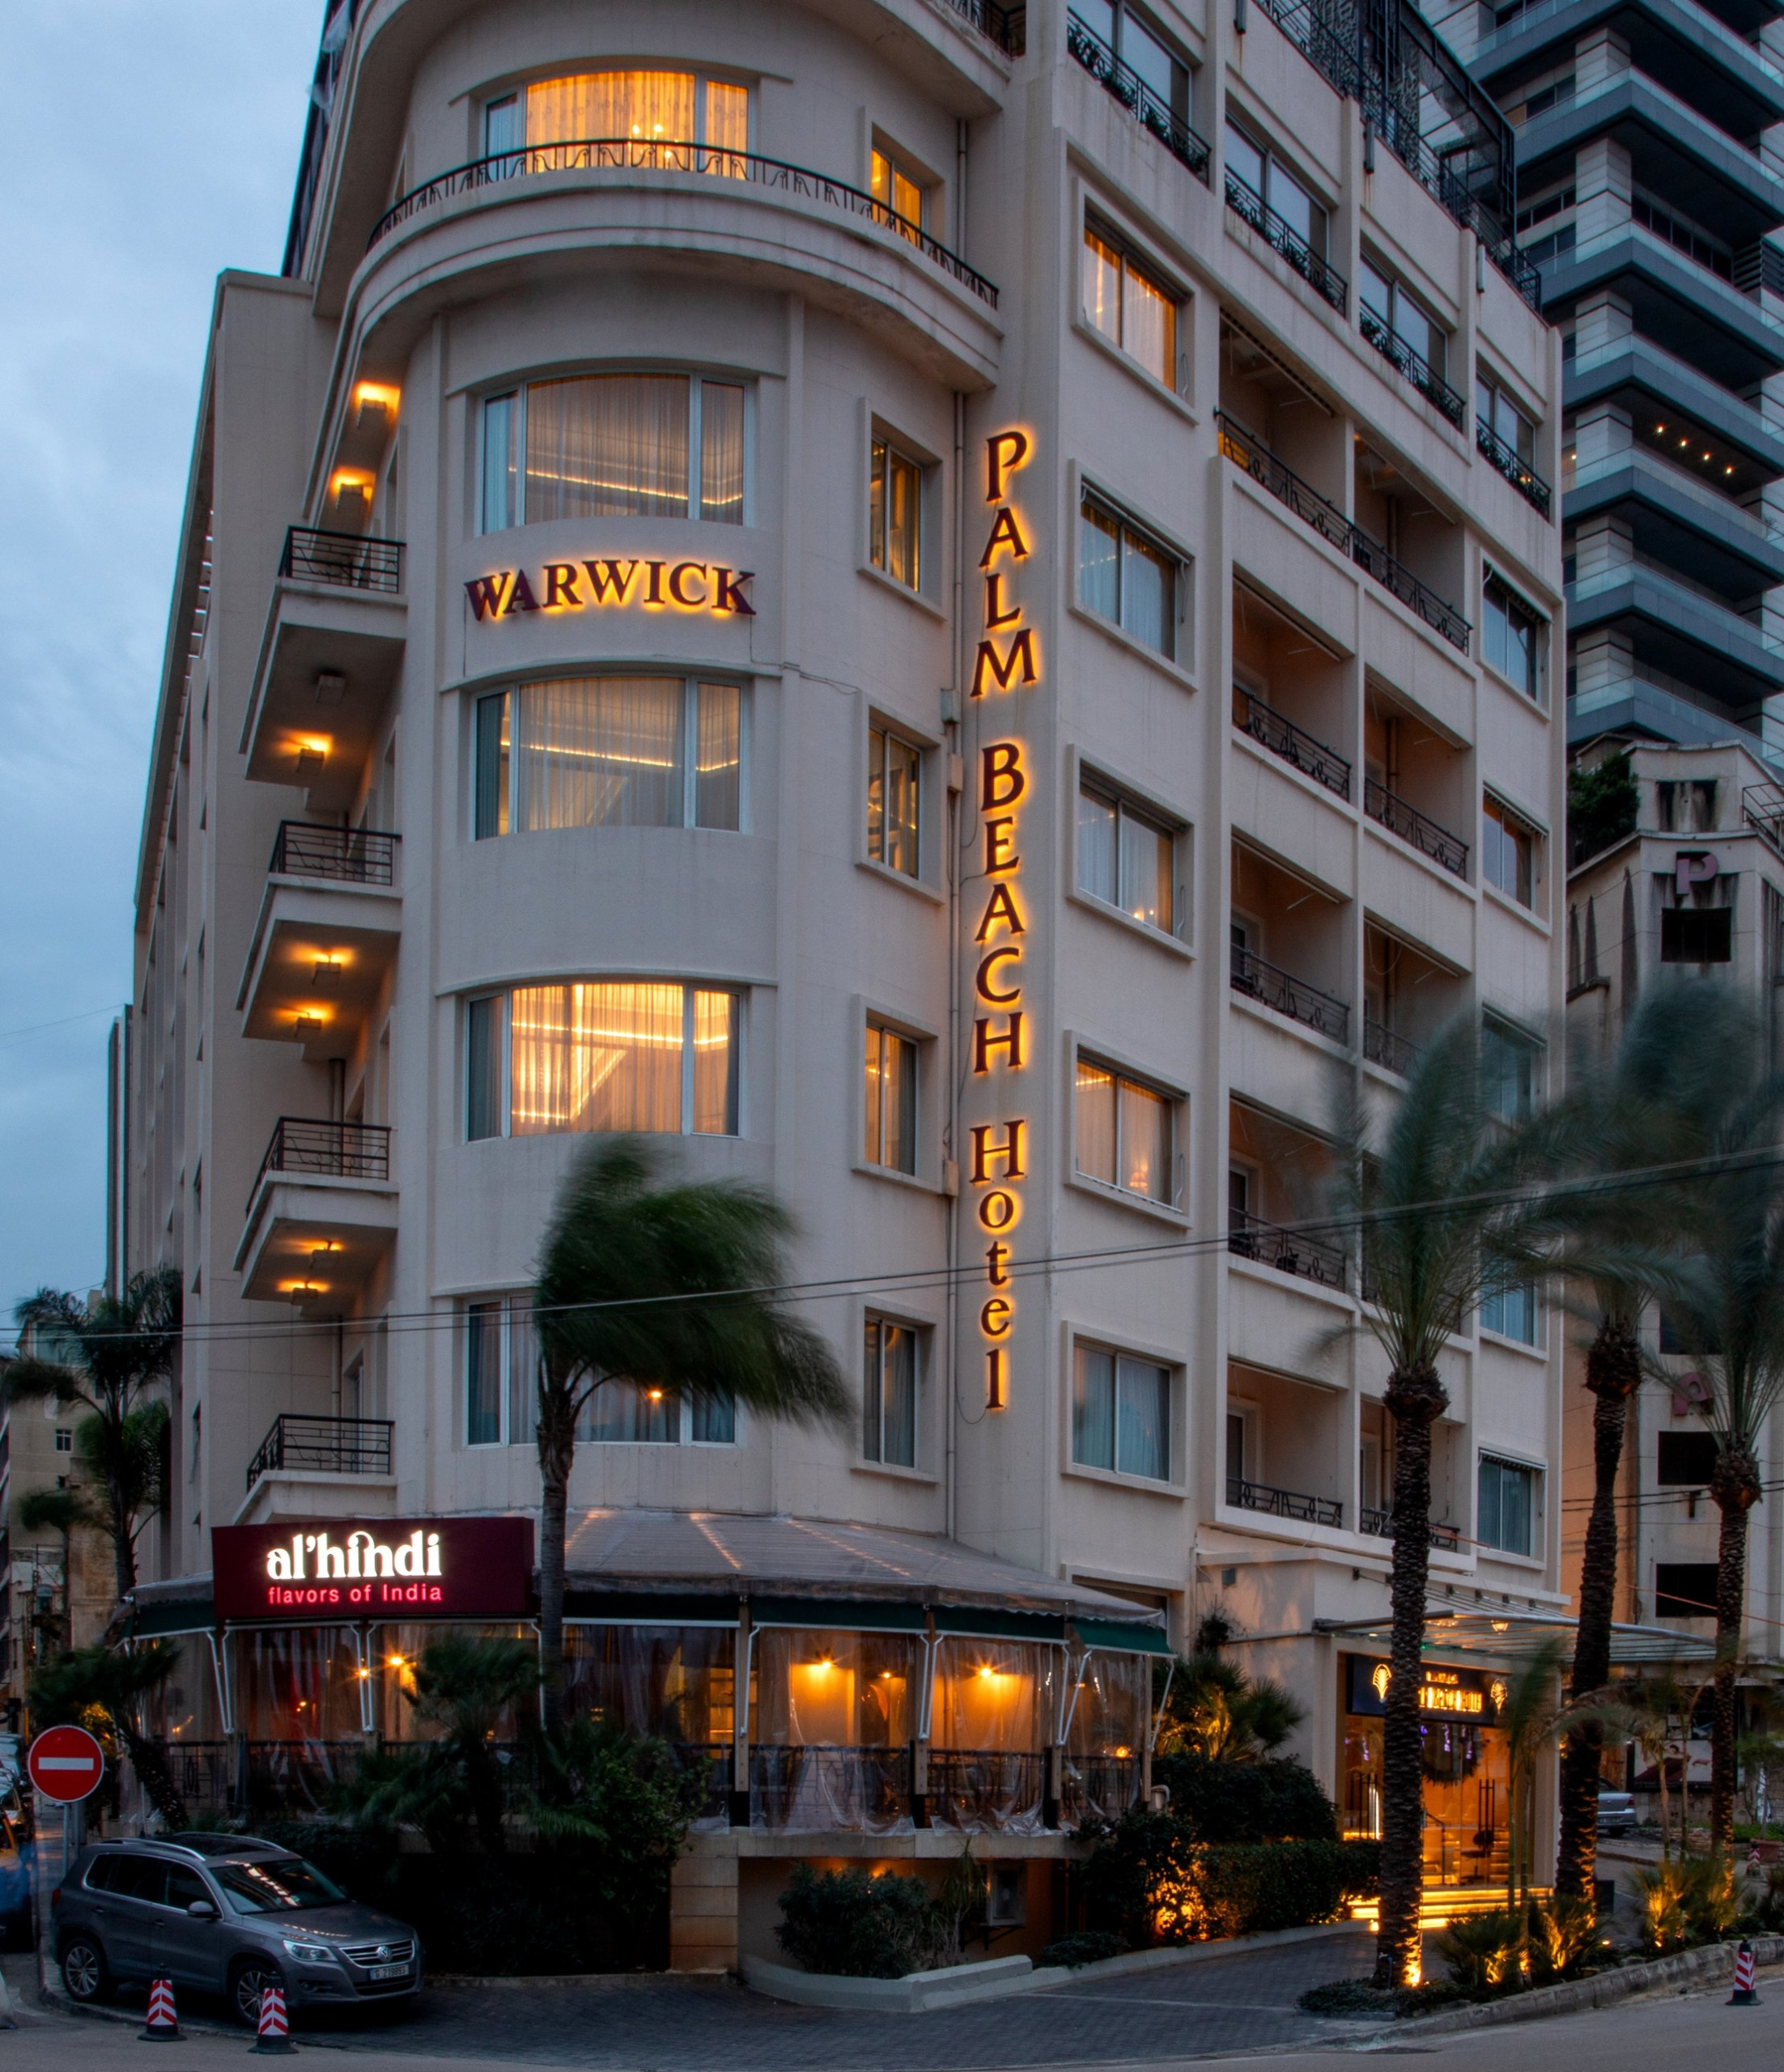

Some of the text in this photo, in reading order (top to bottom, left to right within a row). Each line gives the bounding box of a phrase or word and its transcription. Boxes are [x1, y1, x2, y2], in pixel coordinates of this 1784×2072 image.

[464, 558, 757, 622] WARWICK
[969, 431, 1038, 1410] PALM BEACH Hotel
[266, 1530, 442, 1580] al'hindi
[268, 1582, 443, 1605] flavors of India
